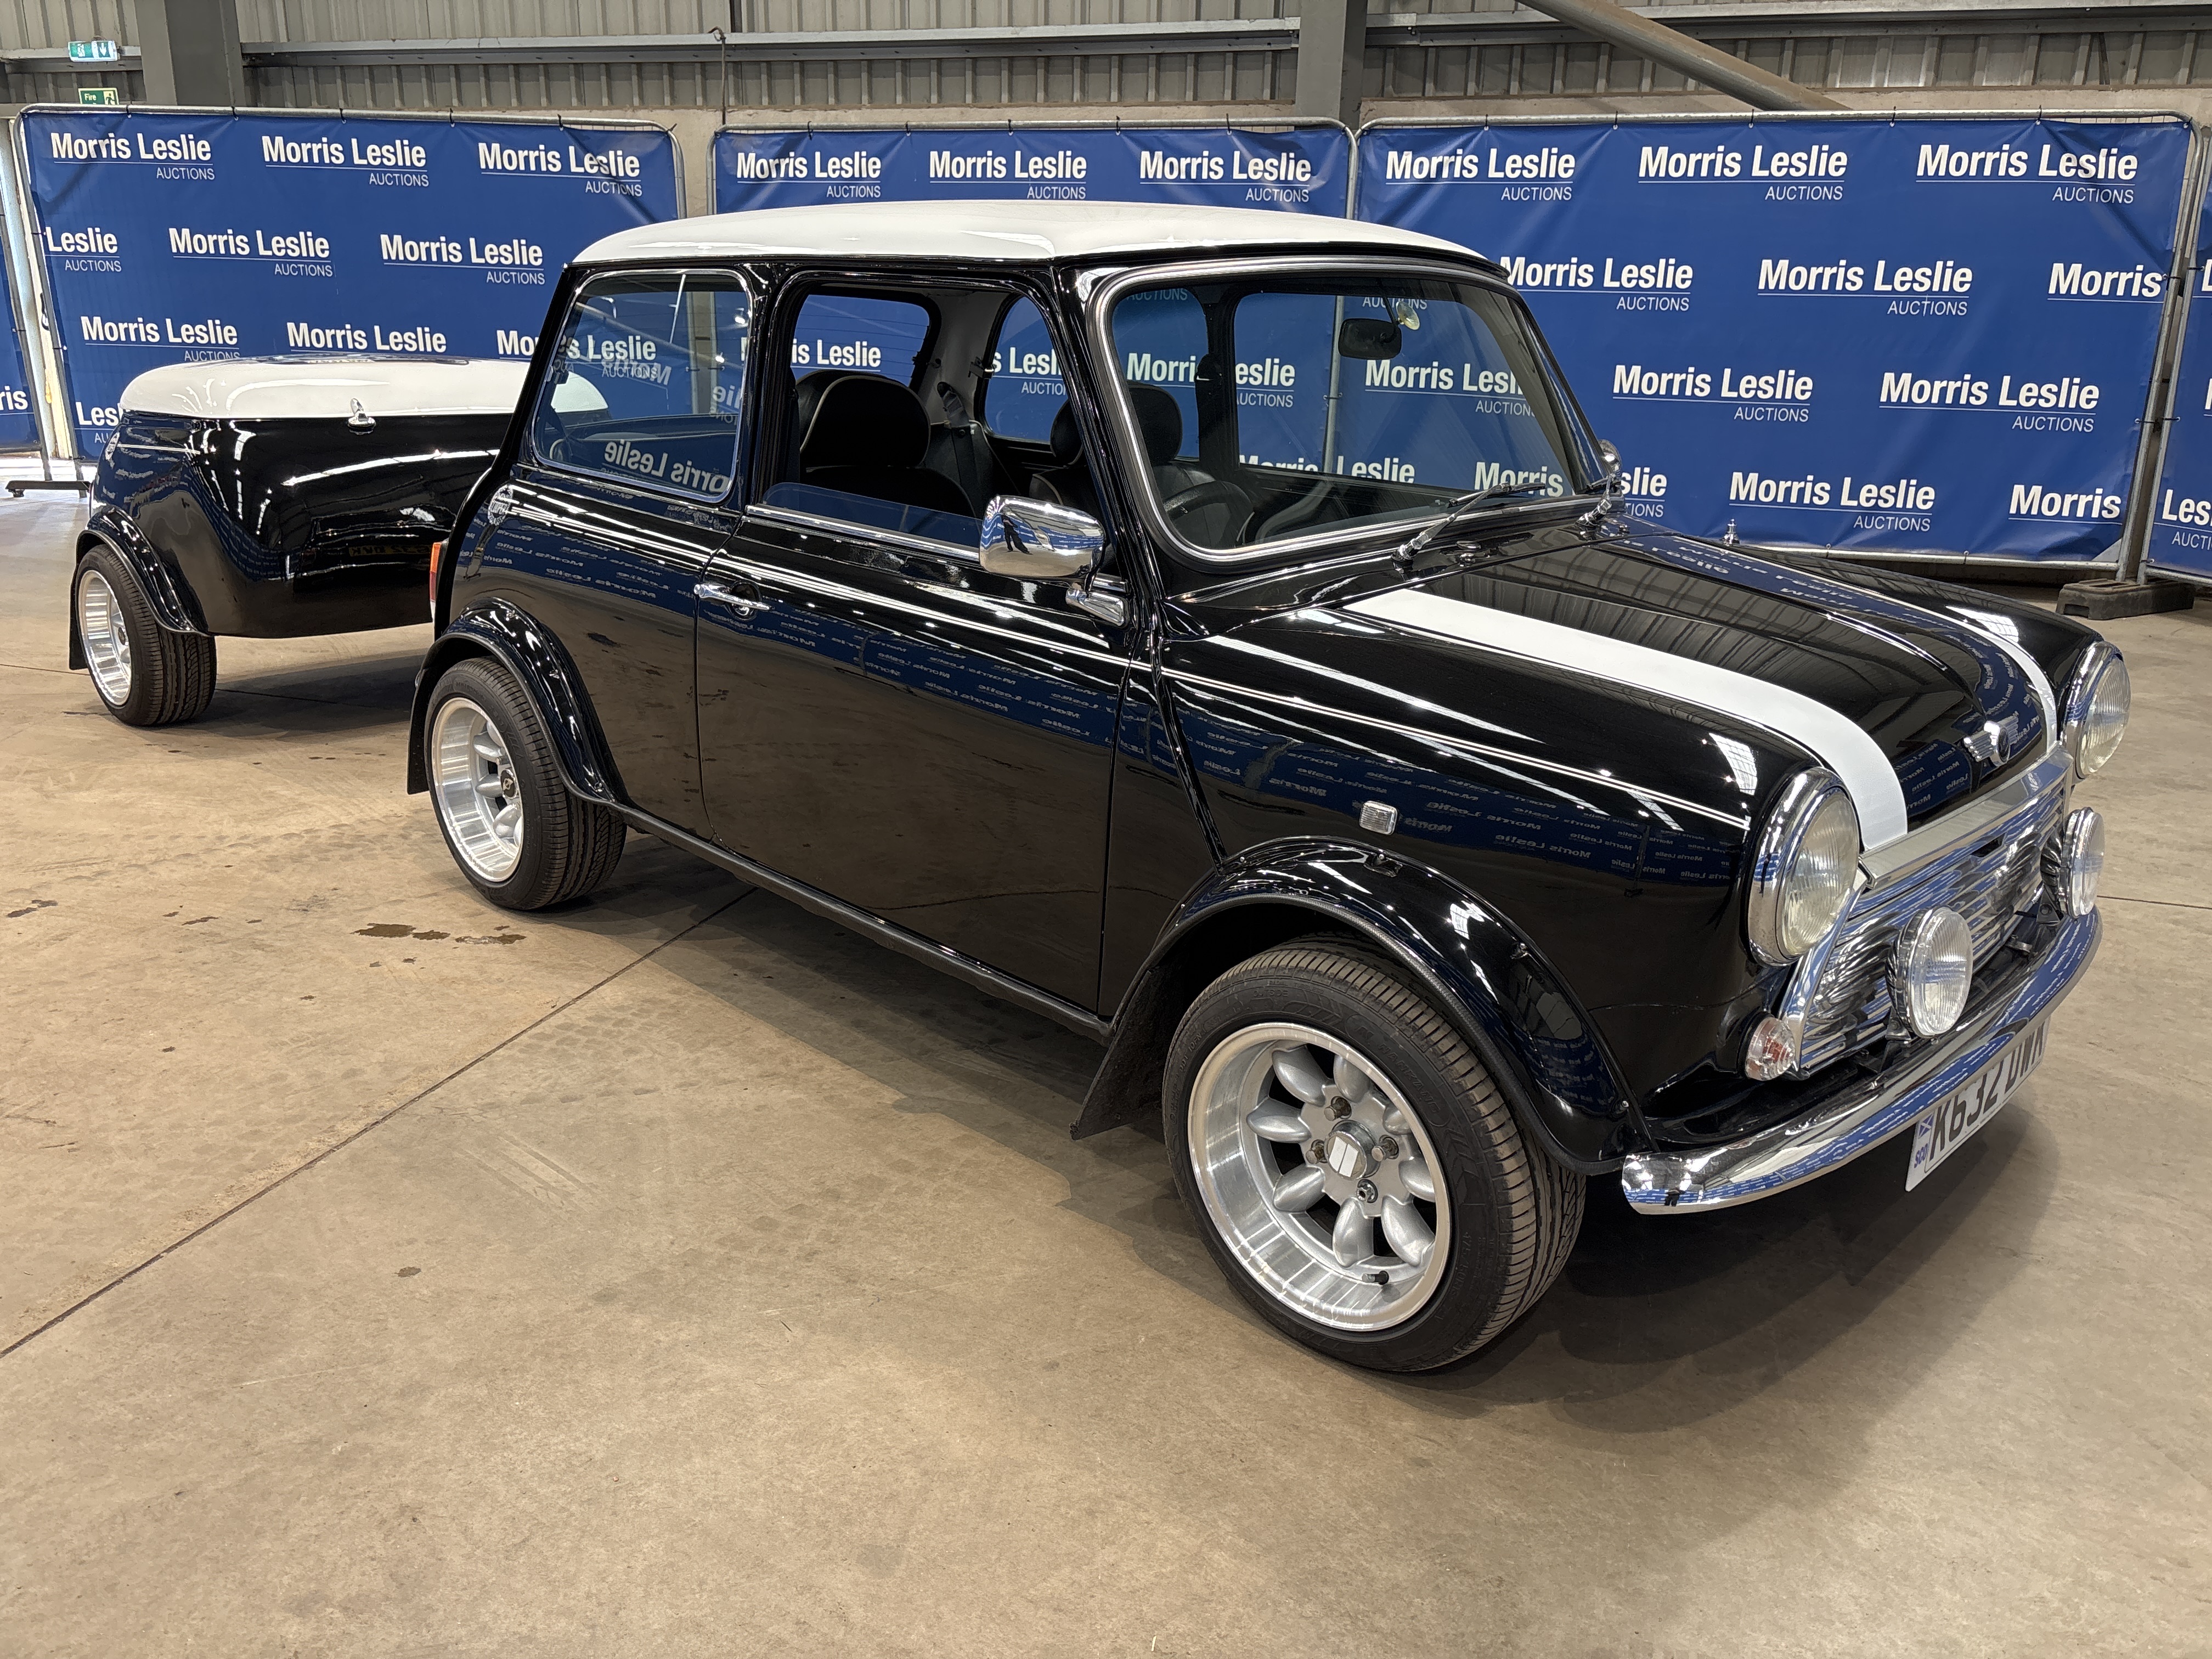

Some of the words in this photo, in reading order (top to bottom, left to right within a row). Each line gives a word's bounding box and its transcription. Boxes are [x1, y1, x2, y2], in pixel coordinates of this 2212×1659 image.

[51, 133, 131, 159] Morris
[137, 133, 211, 160] Leslie
[262, 136, 344, 163] Morris
[351, 138, 426, 167] Leslie
[478, 143, 561, 172] Morris
[569, 146, 639, 177] Leslie
[157, 167, 215, 180] AUCTIONS
[737, 152, 808, 178] Morris
[815, 151, 881, 178] Leslie
[930, 151, 1006, 178] Morris
[1015, 151, 1086, 178] Leslie
[1141, 151, 1223, 179] Morris
[1233, 151, 1311, 181] Leslie
[1386, 149, 1478, 179] Morris
[1488, 148, 1575, 178] Leslie
[1639, 145, 1741, 177] Morris
[1752, 145, 1847, 177] Leslie
[1917, 144, 2028, 176] Morris
[2039, 144, 2137, 179] Leslie
[370, 173, 428, 187] AUCTIONS
[585, 181, 642, 196] AUCTIONS
[827, 185, 881, 198] AUCTIONS
[1027, 187, 1086, 199] AUCTIONS
[1501, 187, 1572, 200] AUCTIONS
[1765, 186, 1843, 200] AUCTIONS
[1245, 188, 1309, 202] AUCTIONS
[2052, 187, 2134, 204] AUCTIONS
[46, 227, 117, 253] Leslie
[169, 228, 250, 255] Morris
[256, 230, 329, 257] Leslie
[381, 234, 462, 262] Morris
[470, 238, 542, 266] Leslie
[65, 259, 121, 272] AUCTIONS
[275, 263, 332, 276] AUCTIONS
[487, 272, 545, 284] AUCTIONS
[1500, 257, 1594, 287] Morris
[1604, 258, 1692, 289] Leslie
[1758, 259, 1864, 291] Morris
[1874, 261, 1972, 292] Leslie
[2048, 263, 2161, 297] Morris
[1617, 297, 1689, 311] AUCTIONS
[1887, 300, 1967, 317] AUCTIONS
[81, 317, 160, 342] Morris
[166, 319, 237, 345] Leslie
[287, 323, 367, 349] Morris
[374, 325, 446, 352] Leslie
[184, 351, 241, 362] AUCTIONS
[588, 335, 656, 360] Leslie
[817, 340, 881, 367] Leslie
[1365, 359, 1453, 390] Morris
[1613, 365, 1711, 397] Morris
[1721, 368, 1813, 400] Leslie
[1880, 373, 1988, 405] Morris
[1999, 376, 2099, 409] Leslie
[1475, 400, 1535, 417] AUCTION
[1734, 407, 1808, 422] AUCTIONS
[2012, 416, 2094, 432] AUCTIONS
[1730, 472, 1830, 505] Morris
[1841, 477, 1934, 509] Leslie
[2010, 485, 2121, 518] Morris
[2162, 489, 2212, 526] Les
[1854, 516, 1930, 531] AUCTIONS
[1914, 1143, 1928, 1169] SCO
